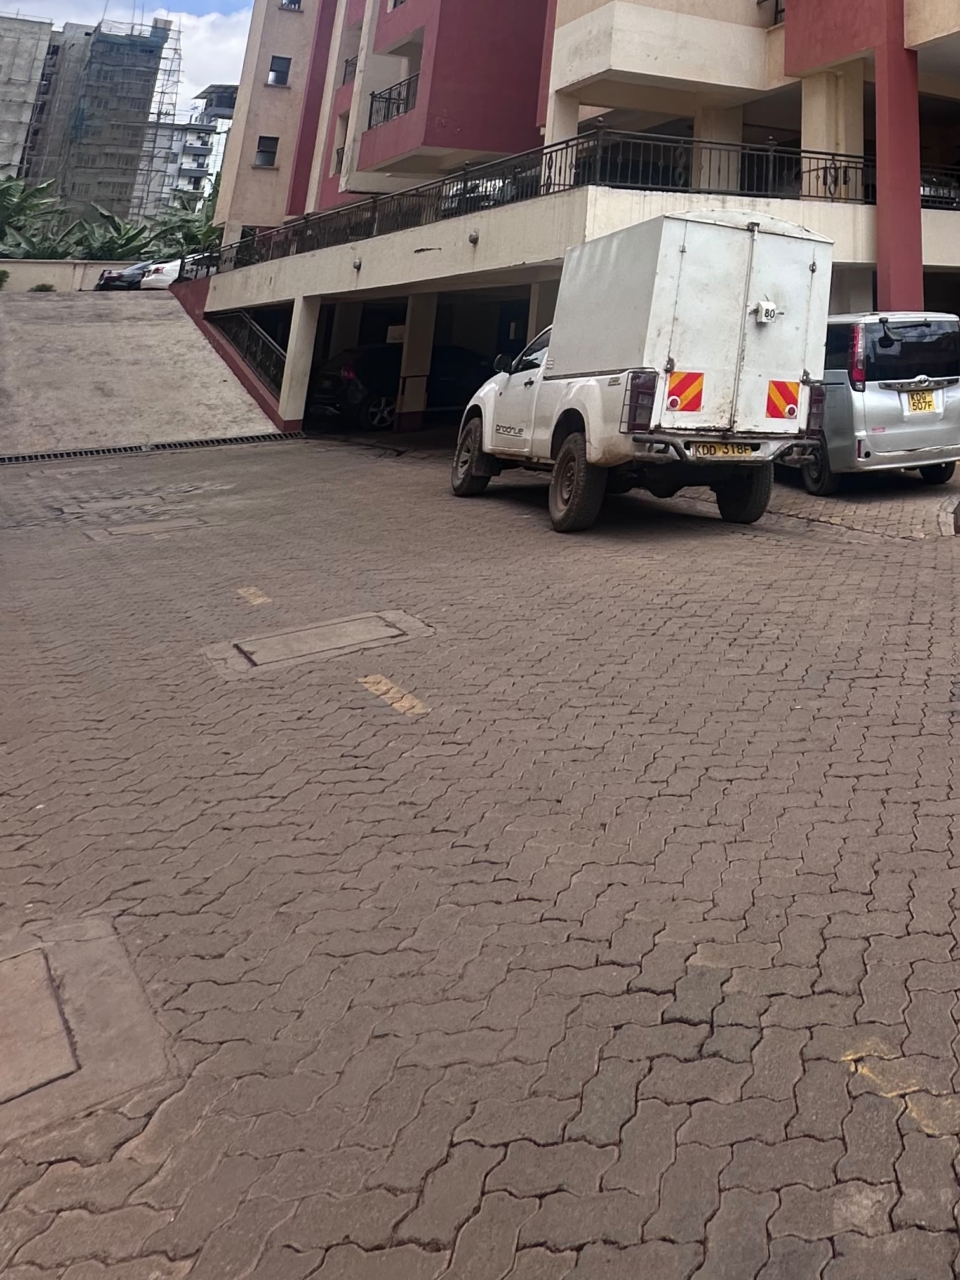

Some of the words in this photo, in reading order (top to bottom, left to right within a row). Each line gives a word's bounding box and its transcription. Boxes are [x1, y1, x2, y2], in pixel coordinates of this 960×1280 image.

[764, 308, 776, 319] 80
[910, 392, 927, 402] KDG
[912, 400, 933, 411] 507F
[695, 444, 717, 456] KDD
[722, 443, 751, 455] 318F
